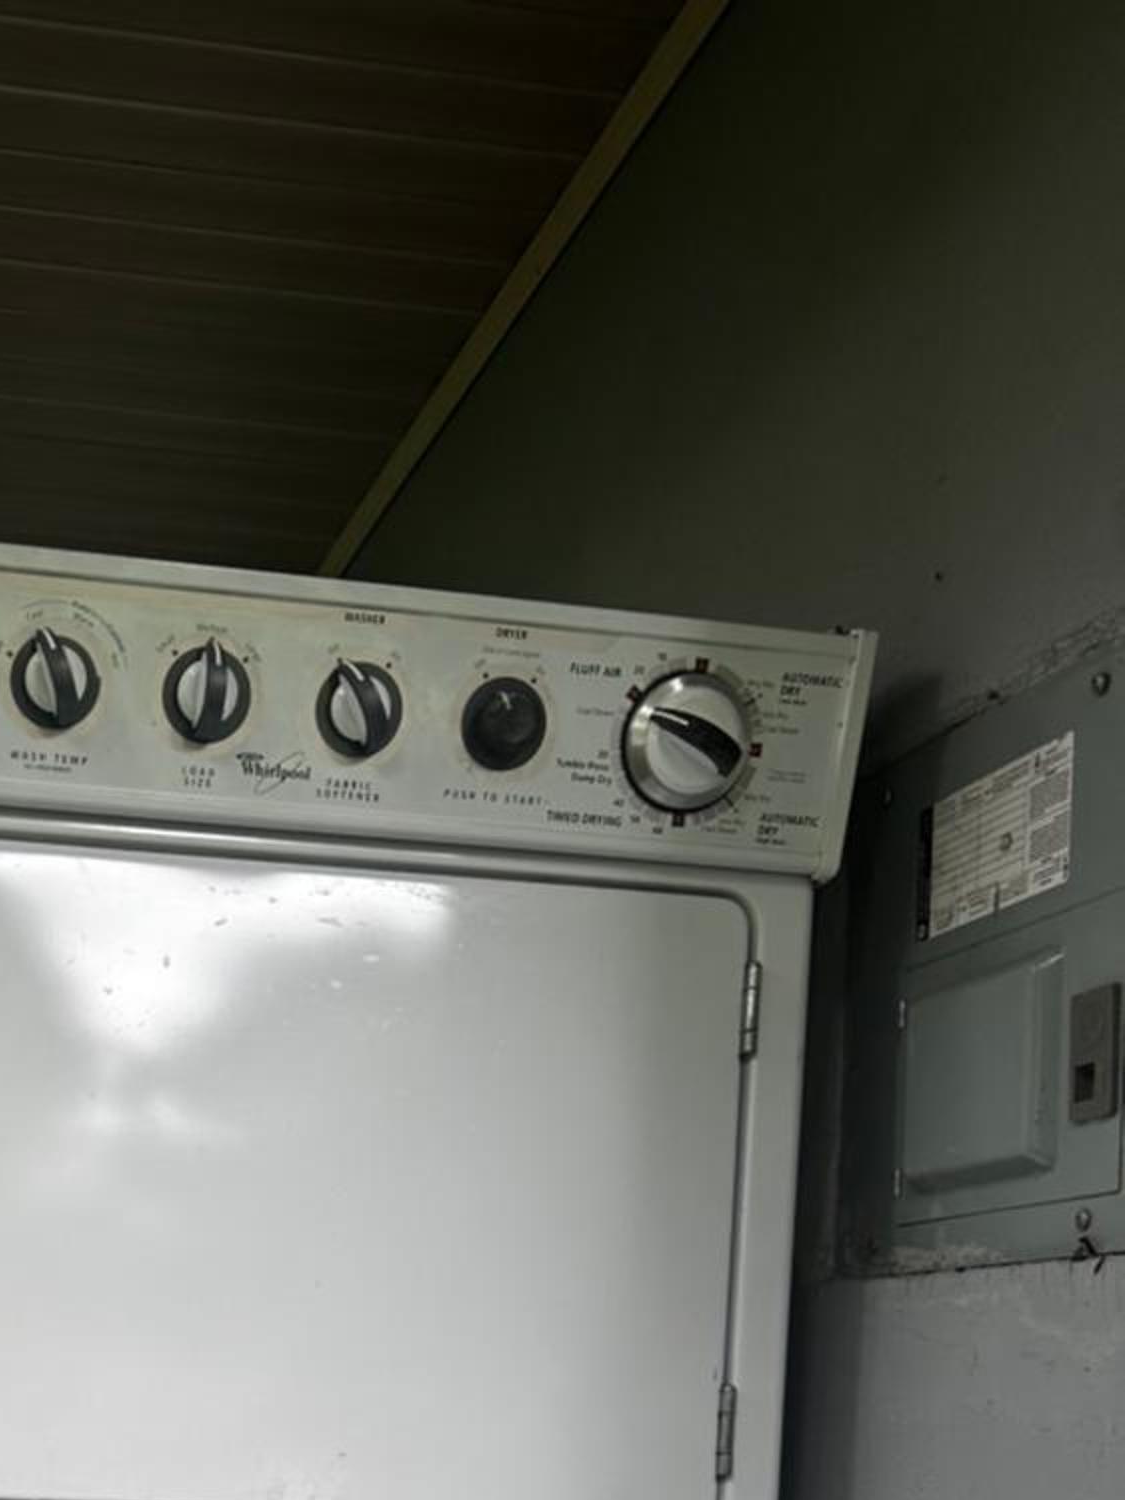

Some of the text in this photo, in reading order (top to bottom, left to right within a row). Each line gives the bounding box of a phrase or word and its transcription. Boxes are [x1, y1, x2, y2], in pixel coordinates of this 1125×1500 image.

[345, 611, 385, 625] WASHER
[496, 627, 527, 641] DRYER
[570, 662, 622, 677] FLUFF AIR
[782, 672, 843, 689] AUTOMATIC
[781, 685, 801, 697] DRY
[11, 750, 88, 765] WASH TEMP
[182, 767, 215, 777] LOAD
[241, 758, 312, 784] Whirlpool
[185, 777, 212, 788] SIZE
[326, 778, 371, 790] FABRIC
[571, 771, 613, 788] Damp Dry
[316, 788, 380, 803] SOFTENER
[443, 788, 542, 806] PUSH TO START
[547, 809, 623, 828] TIMED DRYING
[760, 812, 820, 828] AUTOMATIC
[757, 825, 779, 836] DRY
